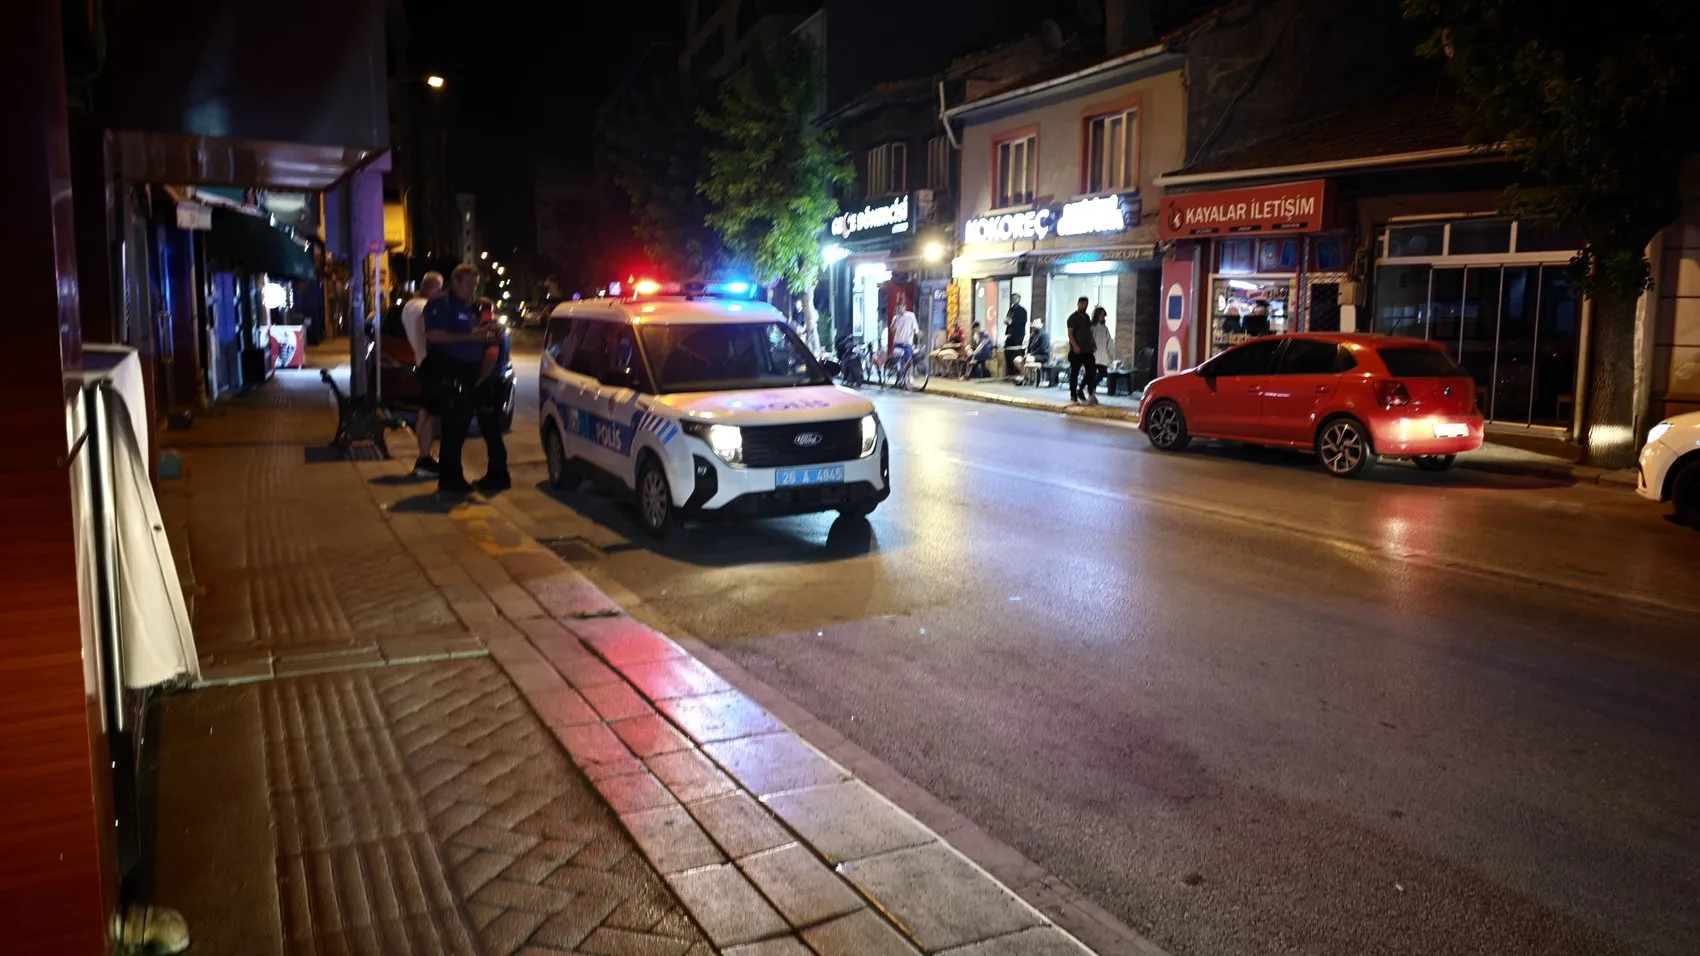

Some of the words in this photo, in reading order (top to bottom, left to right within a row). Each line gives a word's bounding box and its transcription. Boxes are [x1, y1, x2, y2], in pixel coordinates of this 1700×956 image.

[1186, 203, 1247, 224] KAYALAR
[1250, 194, 1315, 222] İLETİŞİM
[965, 209, 1049, 242] KOKOREÇ
[596, 422, 621, 452] POLİS
[797, 433, 818, 445] Ford
[803, 470, 809, 484] A
